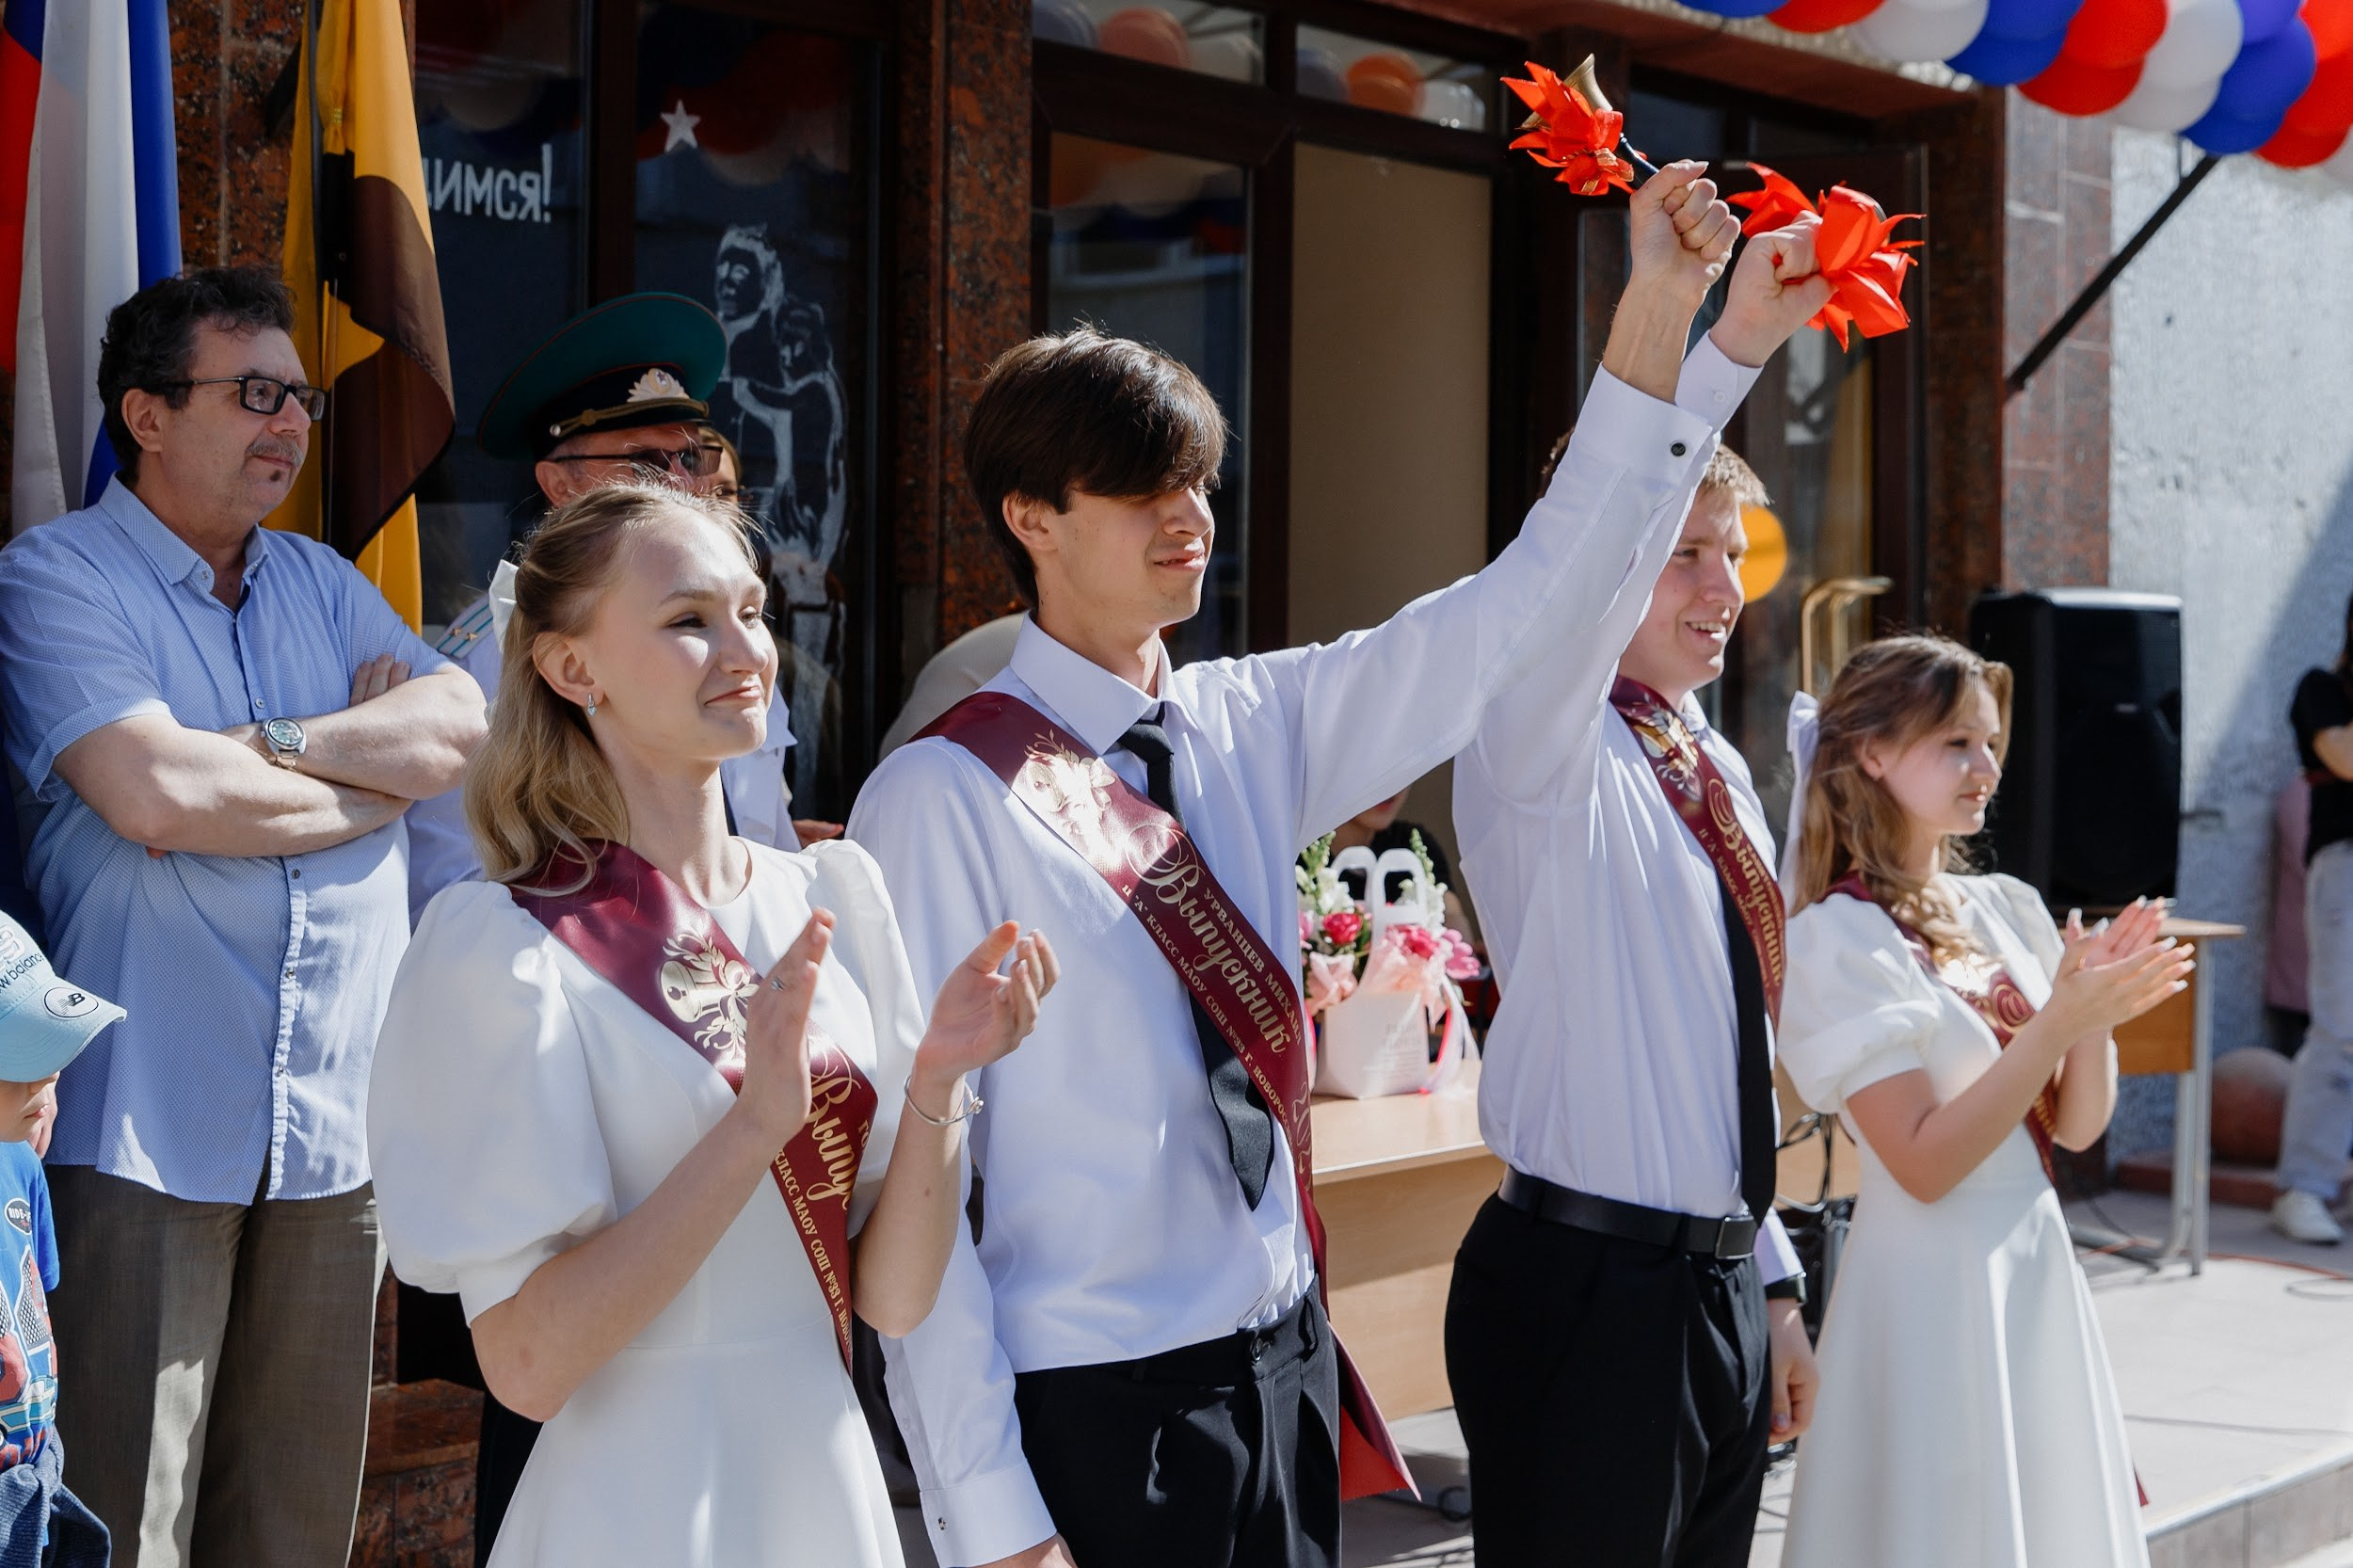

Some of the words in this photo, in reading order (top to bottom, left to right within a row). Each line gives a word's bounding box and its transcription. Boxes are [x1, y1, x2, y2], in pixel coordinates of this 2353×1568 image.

[1146, 914, 1179, 958] КЛАСС
[1177, 956, 1208, 992] МАОУ
[1206, 995, 1228, 1027] СОШ
[1226, 1024, 1246, 1054] №33
[1244, 1051, 1254, 1067] Г.
[1204, 888, 1265, 973] УРВАНЦЕВ
[1265, 972, 1302, 1047] МИХАИЛ
[792, 1195, 818, 1236] МАОУ
[810, 1239, 831, 1272] СОШ
[824, 1271, 840, 1299] №33
[834, 1296, 844, 1312] Г.
